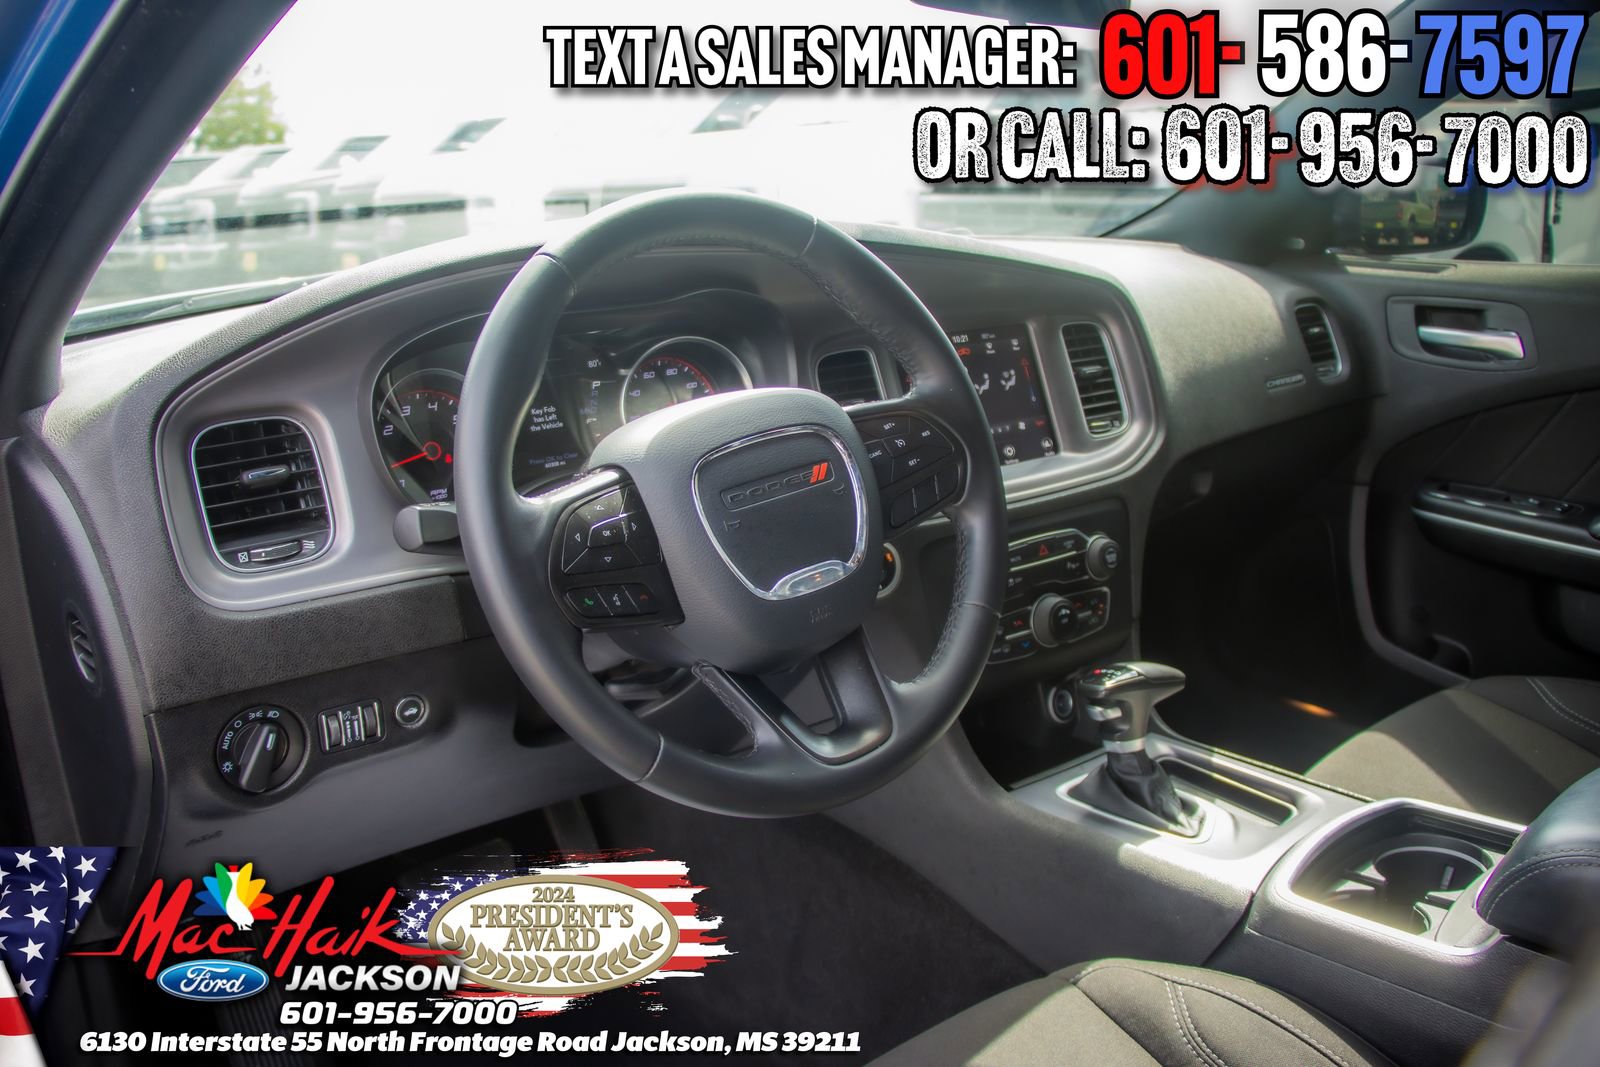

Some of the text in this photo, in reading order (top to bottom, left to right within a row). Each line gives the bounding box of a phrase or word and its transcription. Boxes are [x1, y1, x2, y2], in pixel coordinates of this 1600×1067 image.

[666, 368, 677, 376] 80
[401, 405, 411, 416] 3
[428, 402, 438, 411] 4
[545, 413, 558, 421] Left
[384, 425, 394, 436] 2
[530, 421, 564, 432] the Vehicle
[727, 469, 815, 504] DODGE
[221, 731, 234, 750] AUTO
